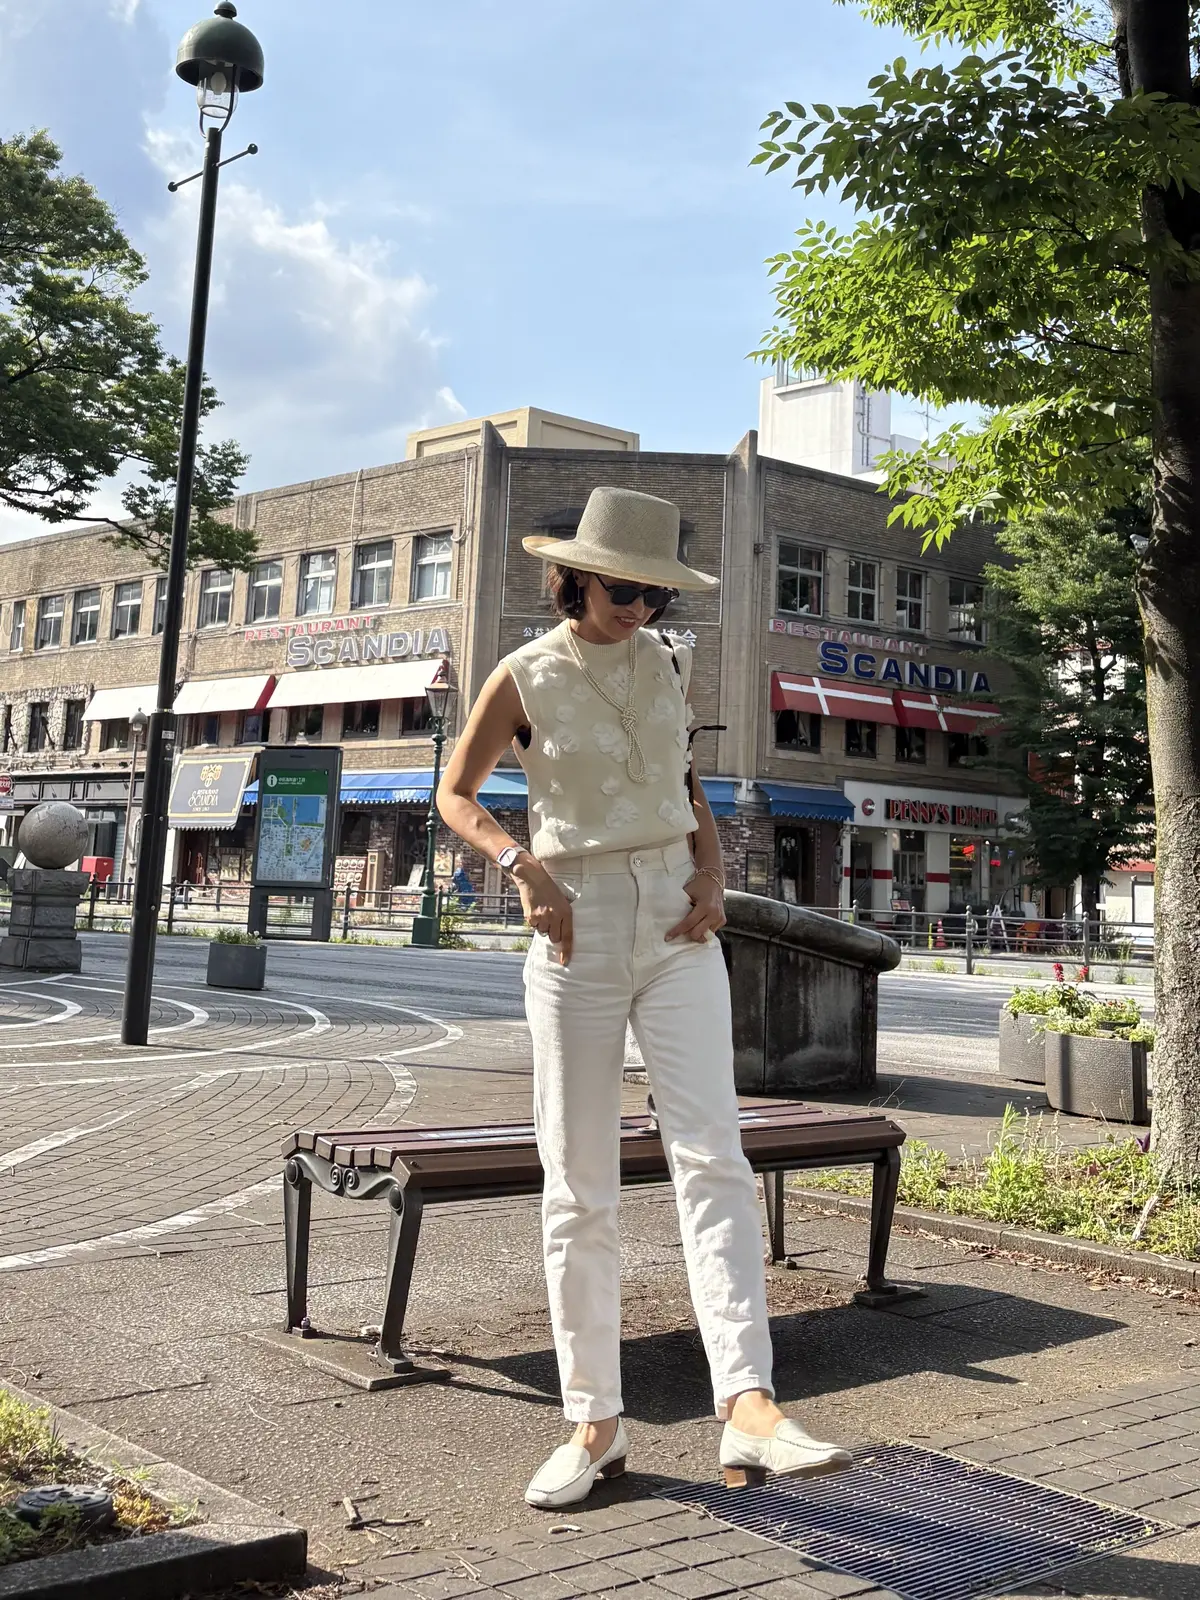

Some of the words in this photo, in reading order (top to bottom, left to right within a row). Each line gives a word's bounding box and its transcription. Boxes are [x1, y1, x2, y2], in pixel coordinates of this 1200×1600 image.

[244, 616, 375, 642] RESTAURANT
[287, 627, 449, 667] SCANDIA
[769, 618, 930, 656] RESTAURANT
[817, 641, 991, 693] SCANDIA
[886, 799, 950, 825] PENNY'S
